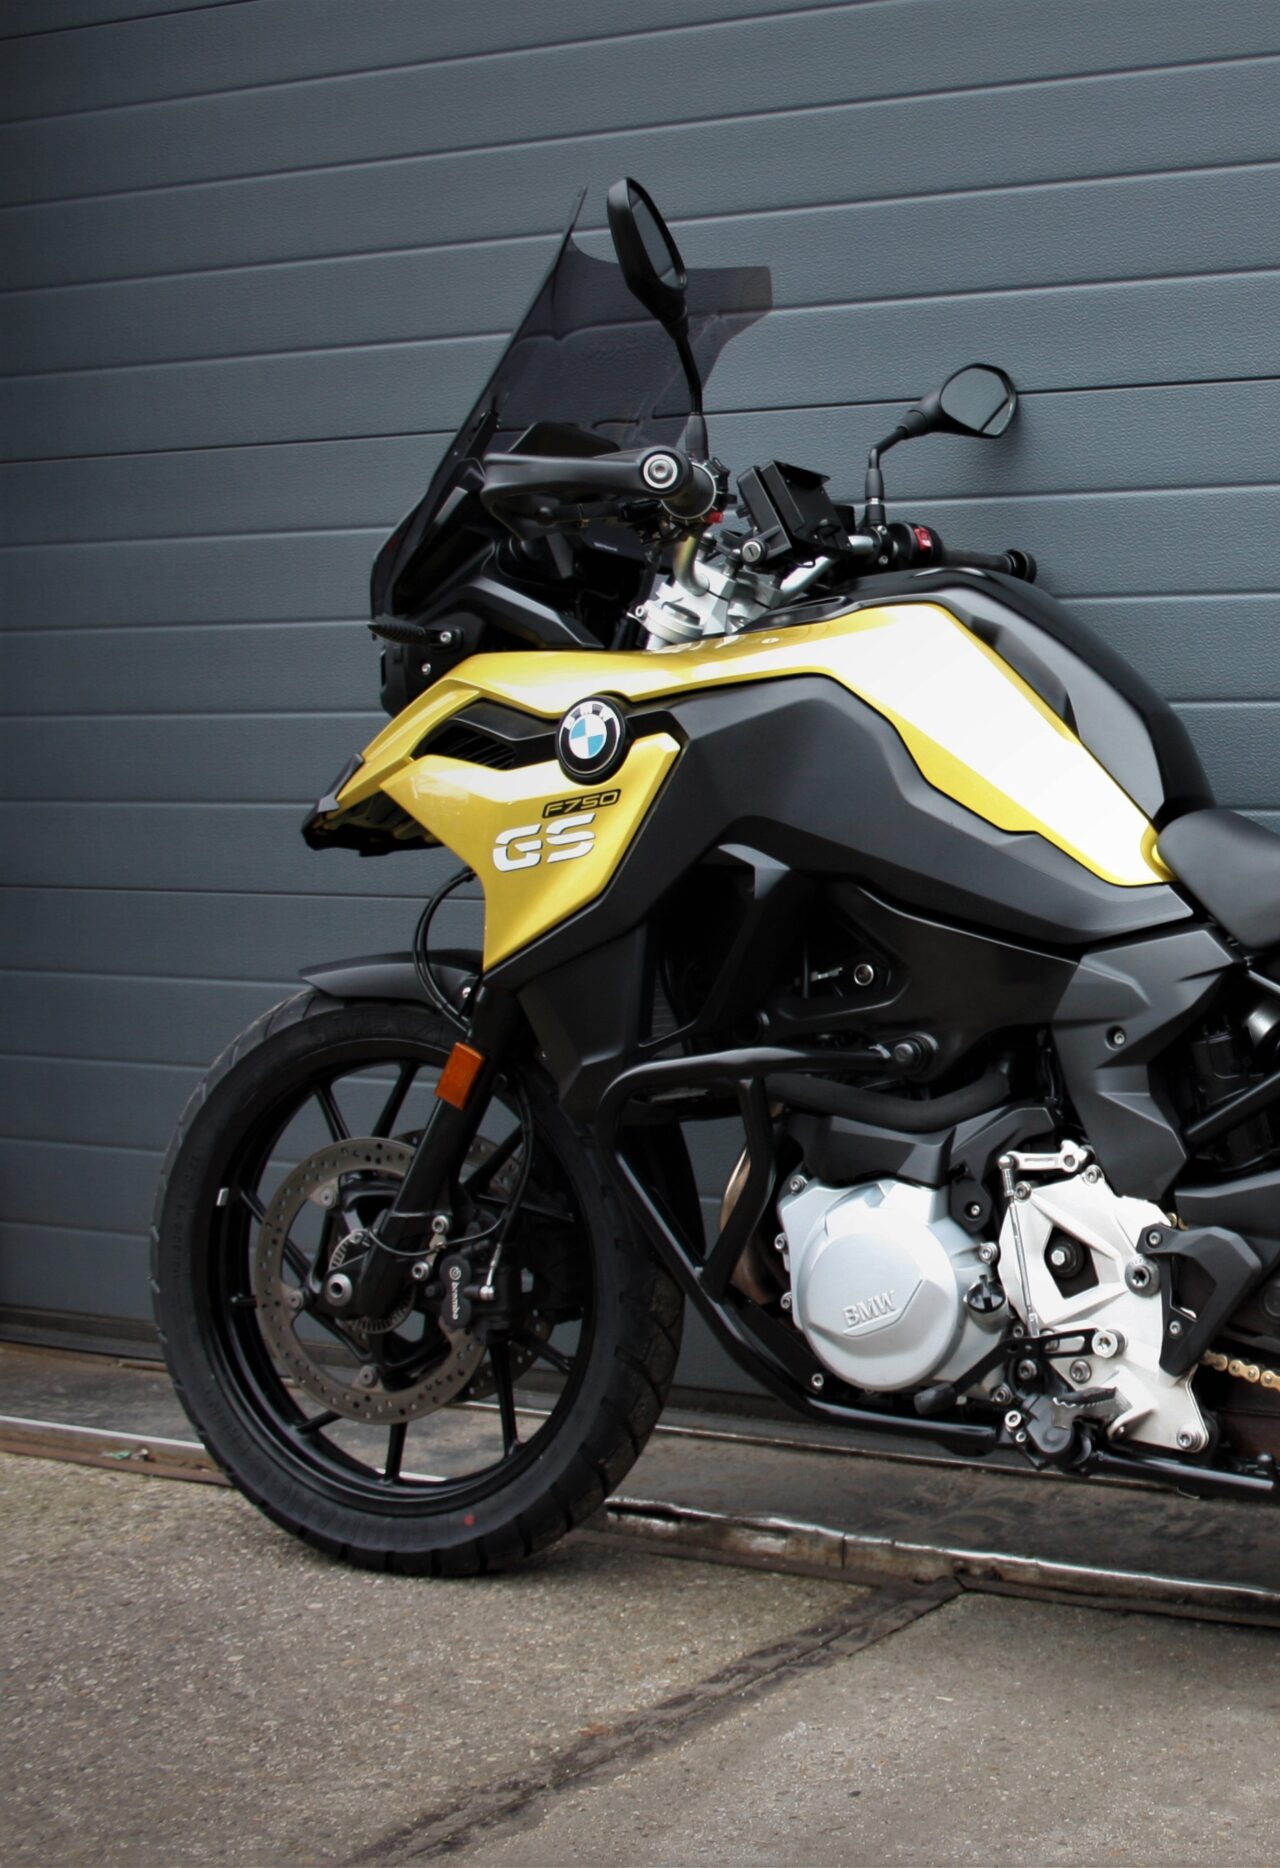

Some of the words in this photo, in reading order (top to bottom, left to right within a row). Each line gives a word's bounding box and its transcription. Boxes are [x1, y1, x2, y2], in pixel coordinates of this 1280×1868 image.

[543, 789, 620, 818] F750
[492, 812, 596, 873] GS
[842, 1292, 898, 1327] BMW
